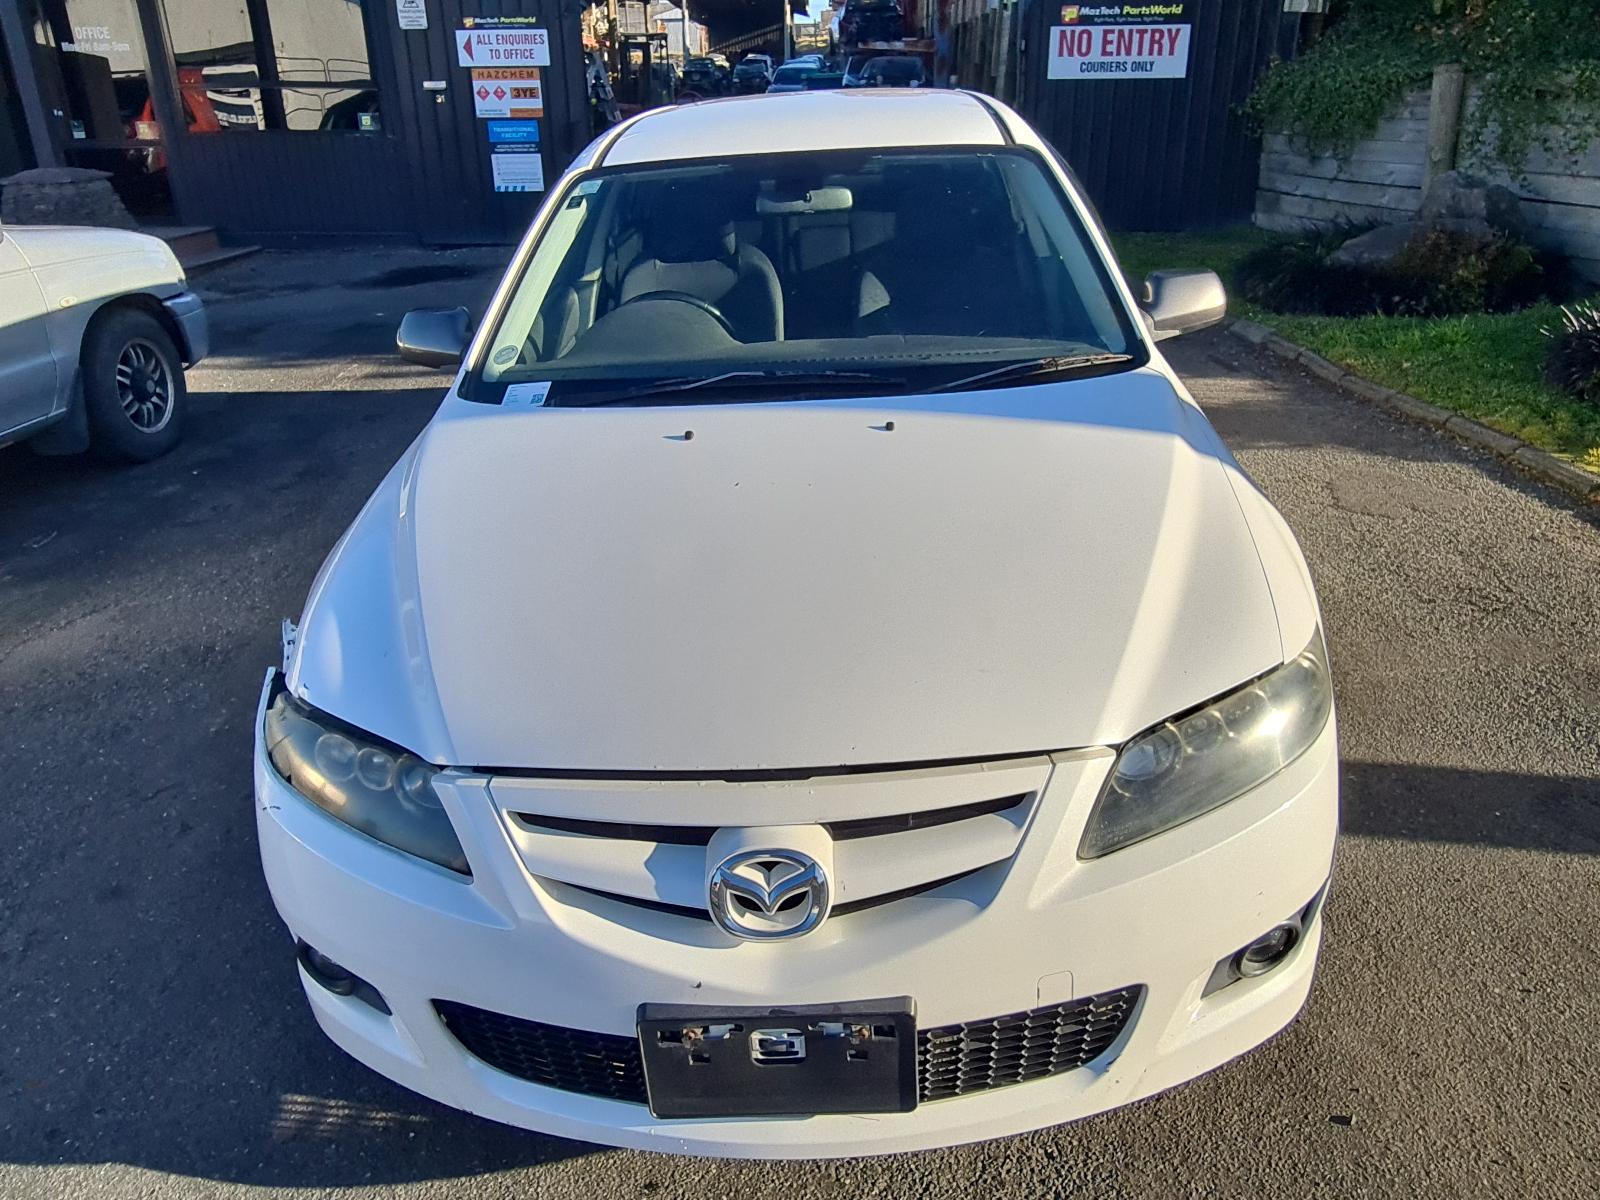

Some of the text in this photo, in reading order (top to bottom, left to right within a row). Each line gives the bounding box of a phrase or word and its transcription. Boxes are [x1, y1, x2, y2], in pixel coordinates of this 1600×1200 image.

[1079, 4, 1184, 16] MazTech PartsWorld
[74, 26, 111, 40] OFFICE
[476, 33, 545, 46] ALL ENQUIRIES
[1057, 28, 1182, 58] NO ENTRY
[489, 48, 535, 60] TO OFFICE
[1079, 60, 1155, 74] COURIERS ONLY
[477, 69, 534, 79] HAZCHEM
[513, 88, 536, 98] 3YE
